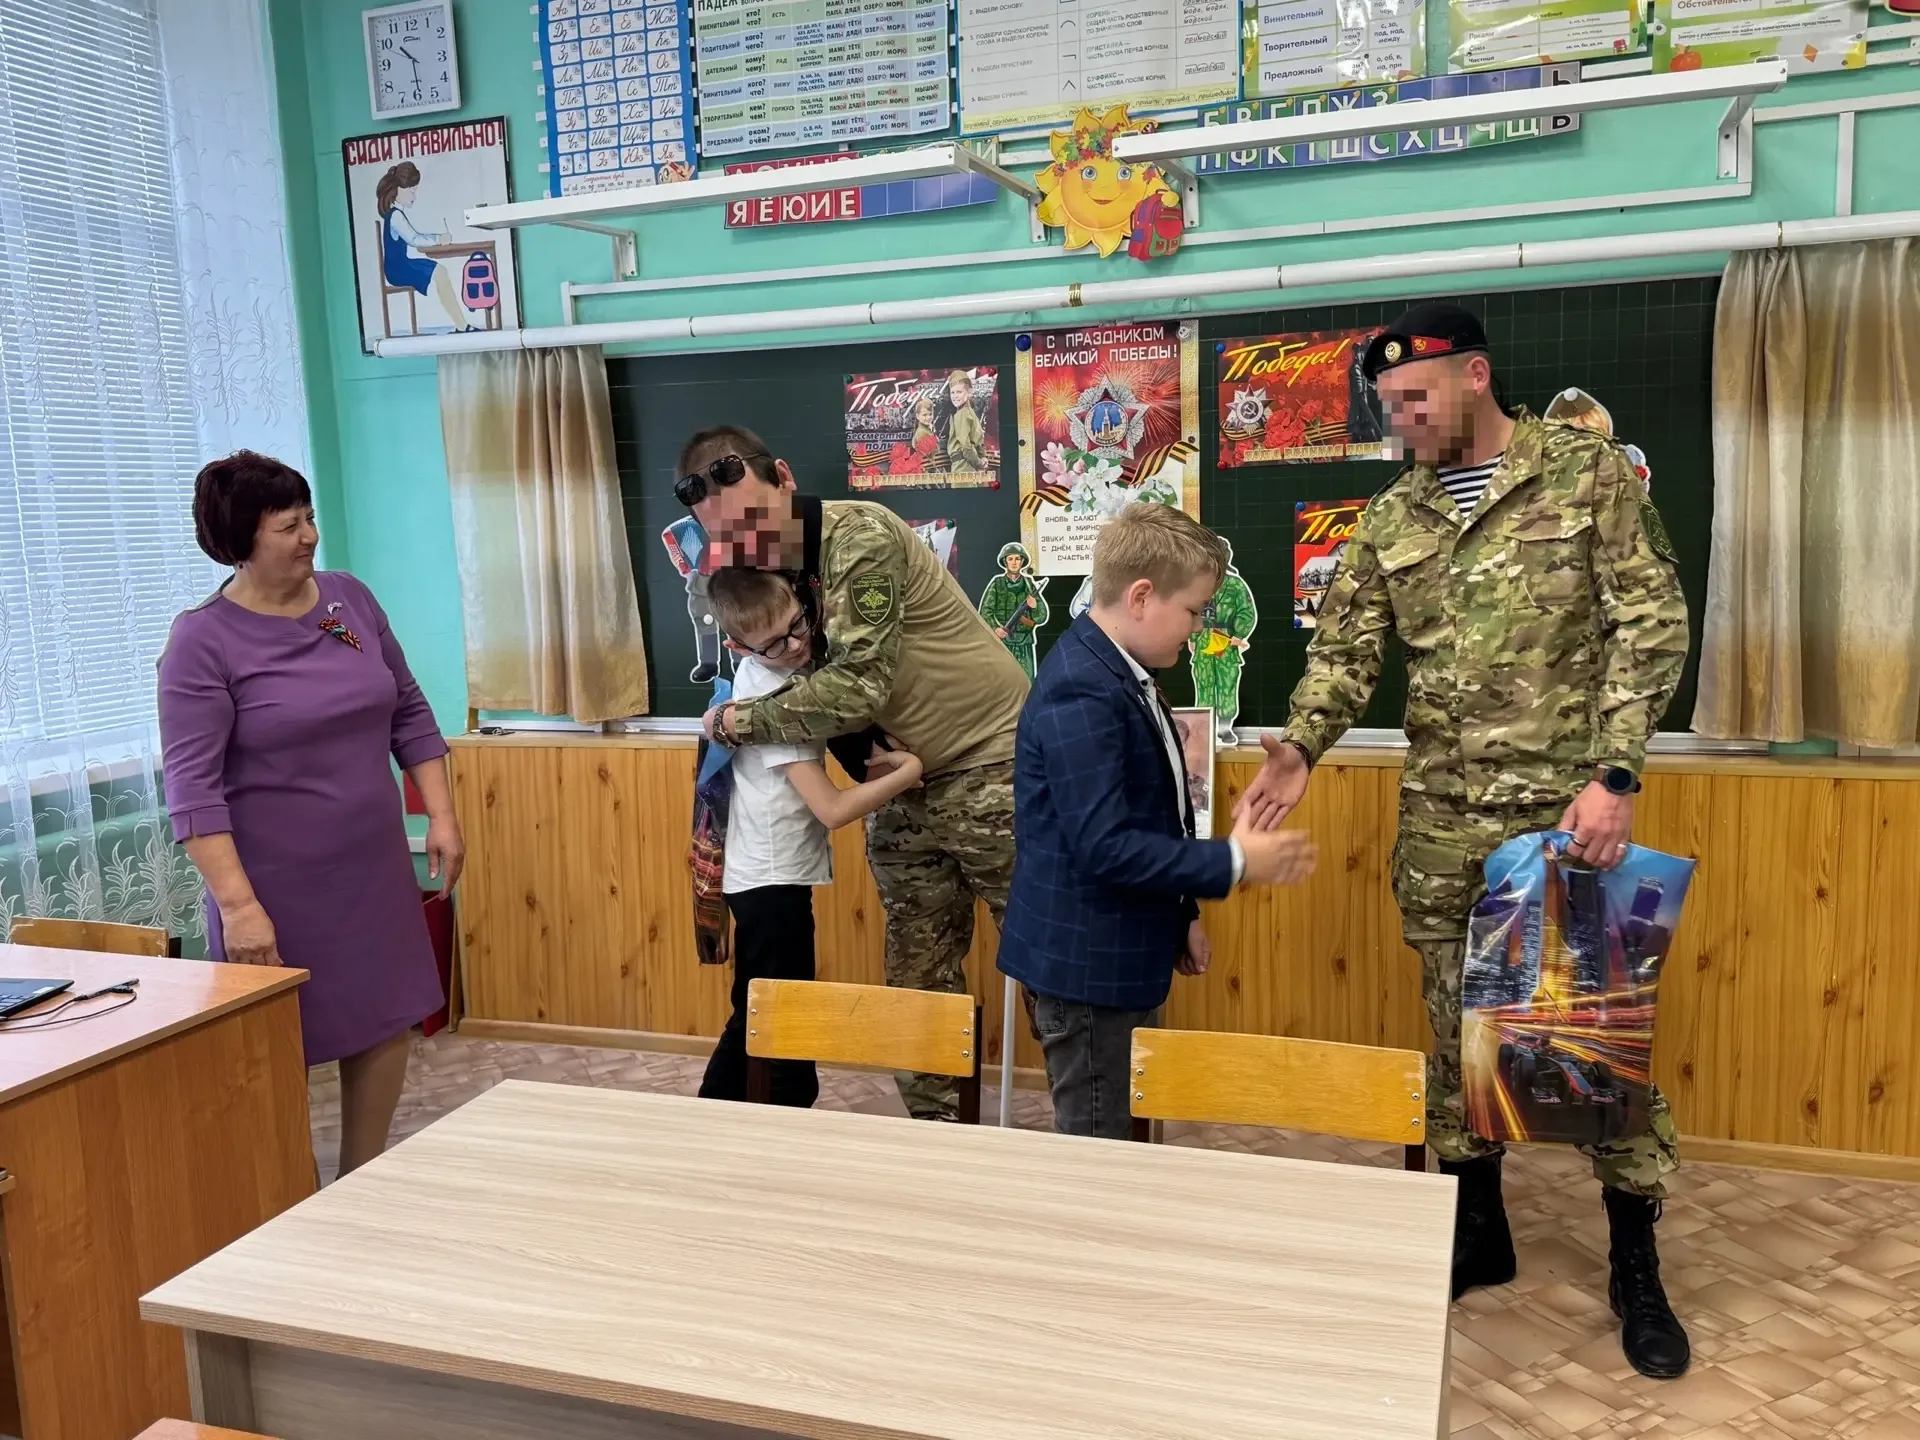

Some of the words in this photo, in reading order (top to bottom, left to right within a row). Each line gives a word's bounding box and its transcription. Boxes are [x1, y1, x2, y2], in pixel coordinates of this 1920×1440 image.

[746, 9, 761, 18] кто?
[1264, 9, 1324, 24] Винительный
[388, 22, 398, 34] 11
[404, 19, 419, 31] 12
[425, 17, 429, 28] 1
[699, 19, 740, 31] ИМЕНИТЕЛЬНЫЙ
[746, 18, 761, 27] что?
[437, 27, 446, 39] 2
[745, 33, 763, 42] кого?
[381, 38, 393, 50] 10
[701, 40, 740, 53] РОДИТЕЛЬНЫЙ
[746, 42, 764, 51] чего?
[1264, 36, 1328, 52] Творительный
[437, 50, 447, 62] 3
[746, 54, 766, 64] кому?
[382, 59, 391, 71] 9
[705, 64, 738, 76] ДАТЕЛЬНЫЙ
[746, 64, 766, 73] чему?
[440, 71, 449, 82] 4
[1264, 66, 1323, 82] Предложный
[385, 81, 394, 93] 8
[748, 79, 766, 88] кого?
[398, 92, 406, 104] 7
[413, 89, 422, 101] 6
[431, 86, 439, 98] 5
[704, 87, 742, 99] ВИНИТЕЛЬНЫЙ
[750, 88, 765, 97] что?
[750, 103, 766, 112] кем?
[704, 111, 744, 123] ТВОРИТЕЛЬНЫЙ
[750, 112, 766, 120] чем?
[346, 137, 392, 166] СИДИ
[398, 121, 503, 159] ПРАВИЛЬНО!
[707, 136, 744, 147] ПРЕДЛОЖНЫЙ
[1268, 146, 1288, 165] К
[1331, 138, 1360, 159] Ш
[1369, 135, 1390, 155] С
[1403, 130, 1426, 150] Х
[1438, 128, 1463, 147] Ц
[1507, 118, 1539, 136] Щ
[1047, 335, 1055, 349] С
[1066, 326, 1164, 348] ПРАЗДНИКОМ
[1035, 348, 1098, 368] ВЕЛИКОЙ
[1110, 344, 1178, 362] ПОБЕДЫ!
[1223, 338, 1351, 388] Победа!
[849, 376, 949, 420] Победа!
[1051, 544, 1071, 552] ДНЁМ
